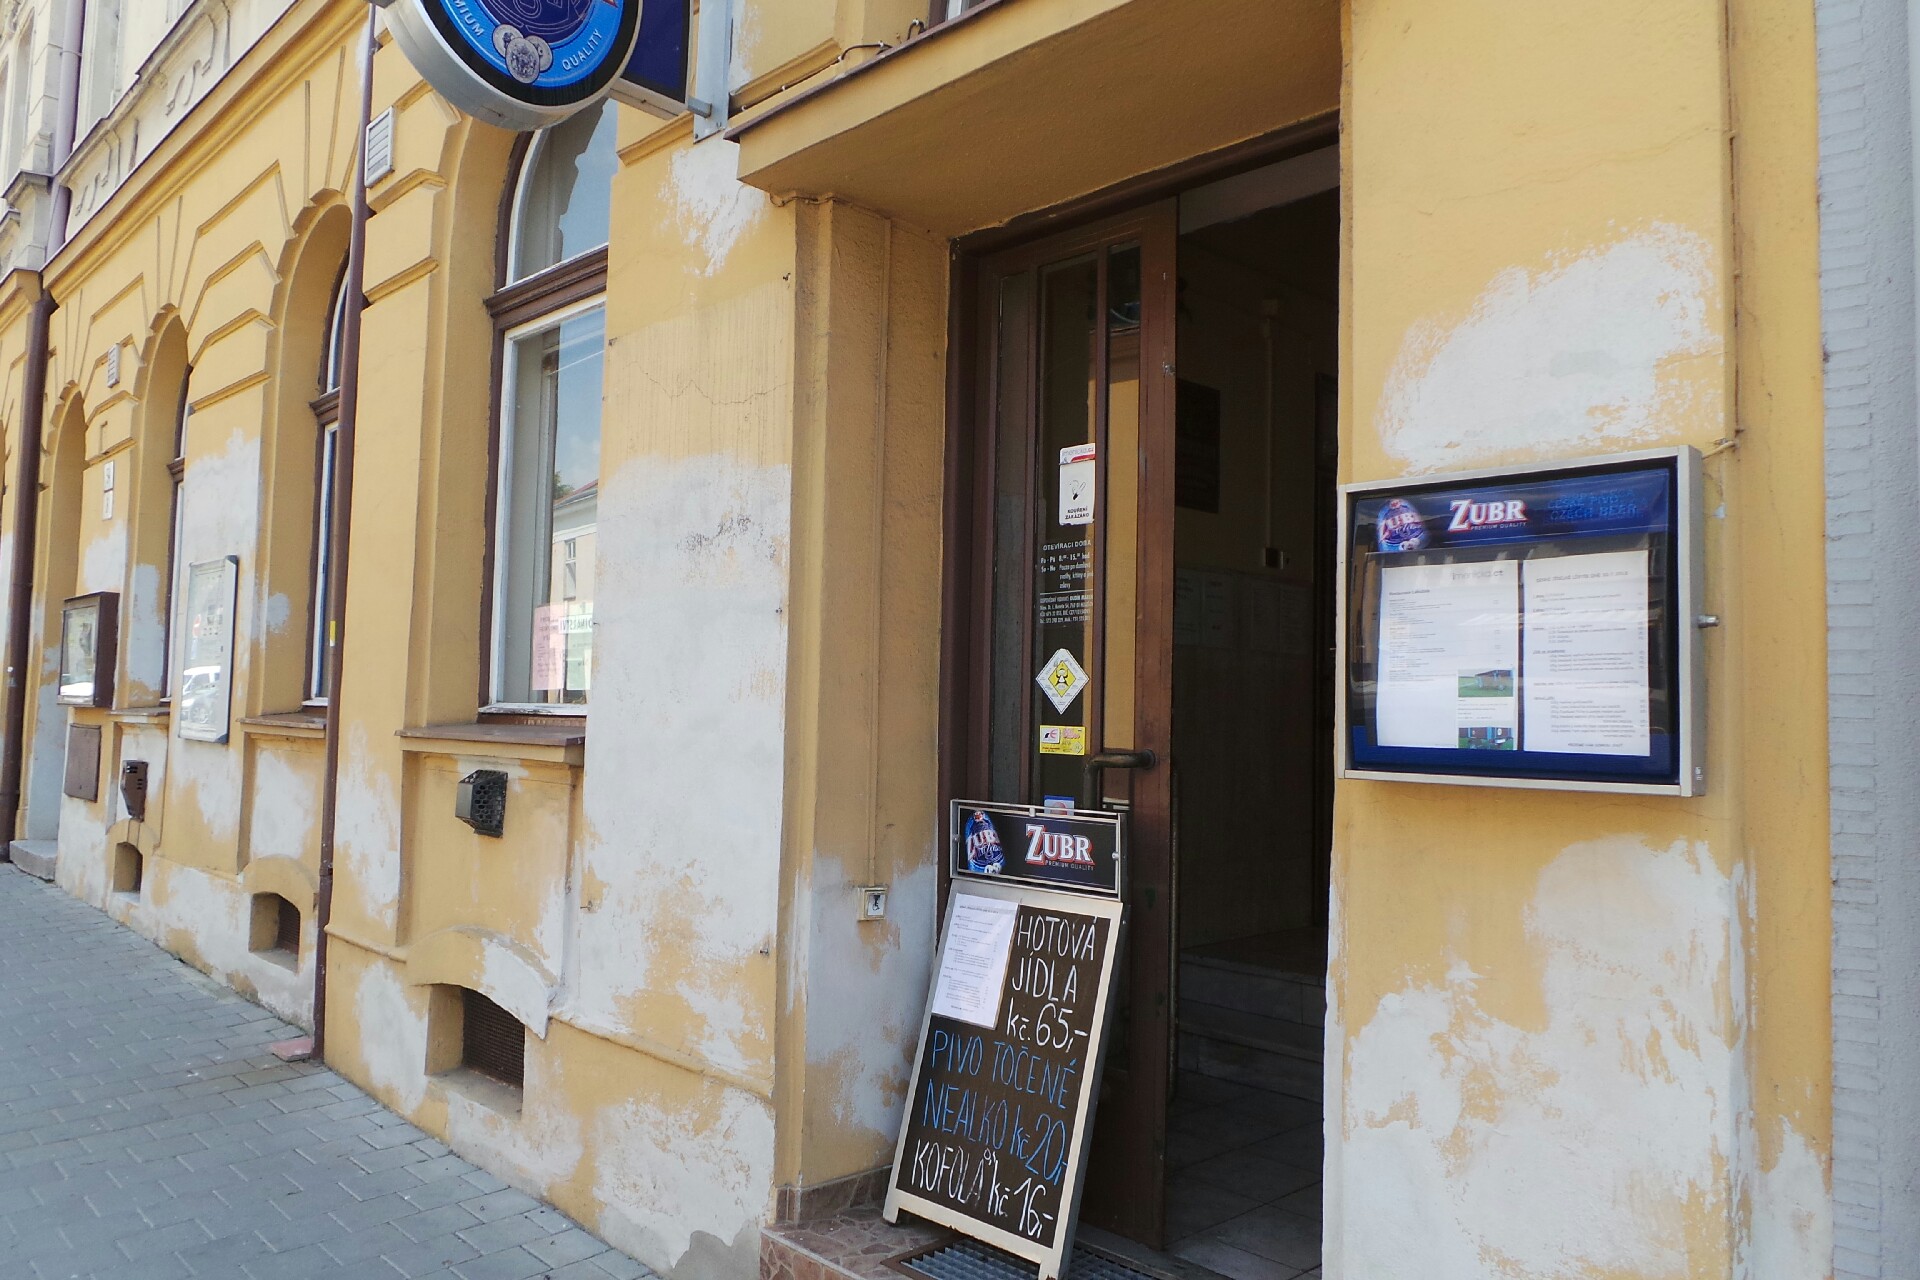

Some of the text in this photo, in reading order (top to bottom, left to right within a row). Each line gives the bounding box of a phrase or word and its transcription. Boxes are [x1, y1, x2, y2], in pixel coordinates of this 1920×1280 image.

[562, 28, 603, 71] QUALITY
[1447, 498, 1529, 534] ZUBR
[1471, 521, 1527, 532] PREMIUM QUALITY
[1074, 539, 1092, 548] DOBA
[1024, 823, 1096, 866] ZUBR
[1045, 859, 1094, 871] PREMIUM QUALITY
[1017, 915, 1099, 961] HOTOVÁ
[1011, 951, 1078, 1004] JÍDLA
[931, 1029, 1078, 1109] PIVO TOČENÉ
[922, 1078, 1008, 1150] NEALKO
[911, 1138, 985, 1206] KOFOLA
